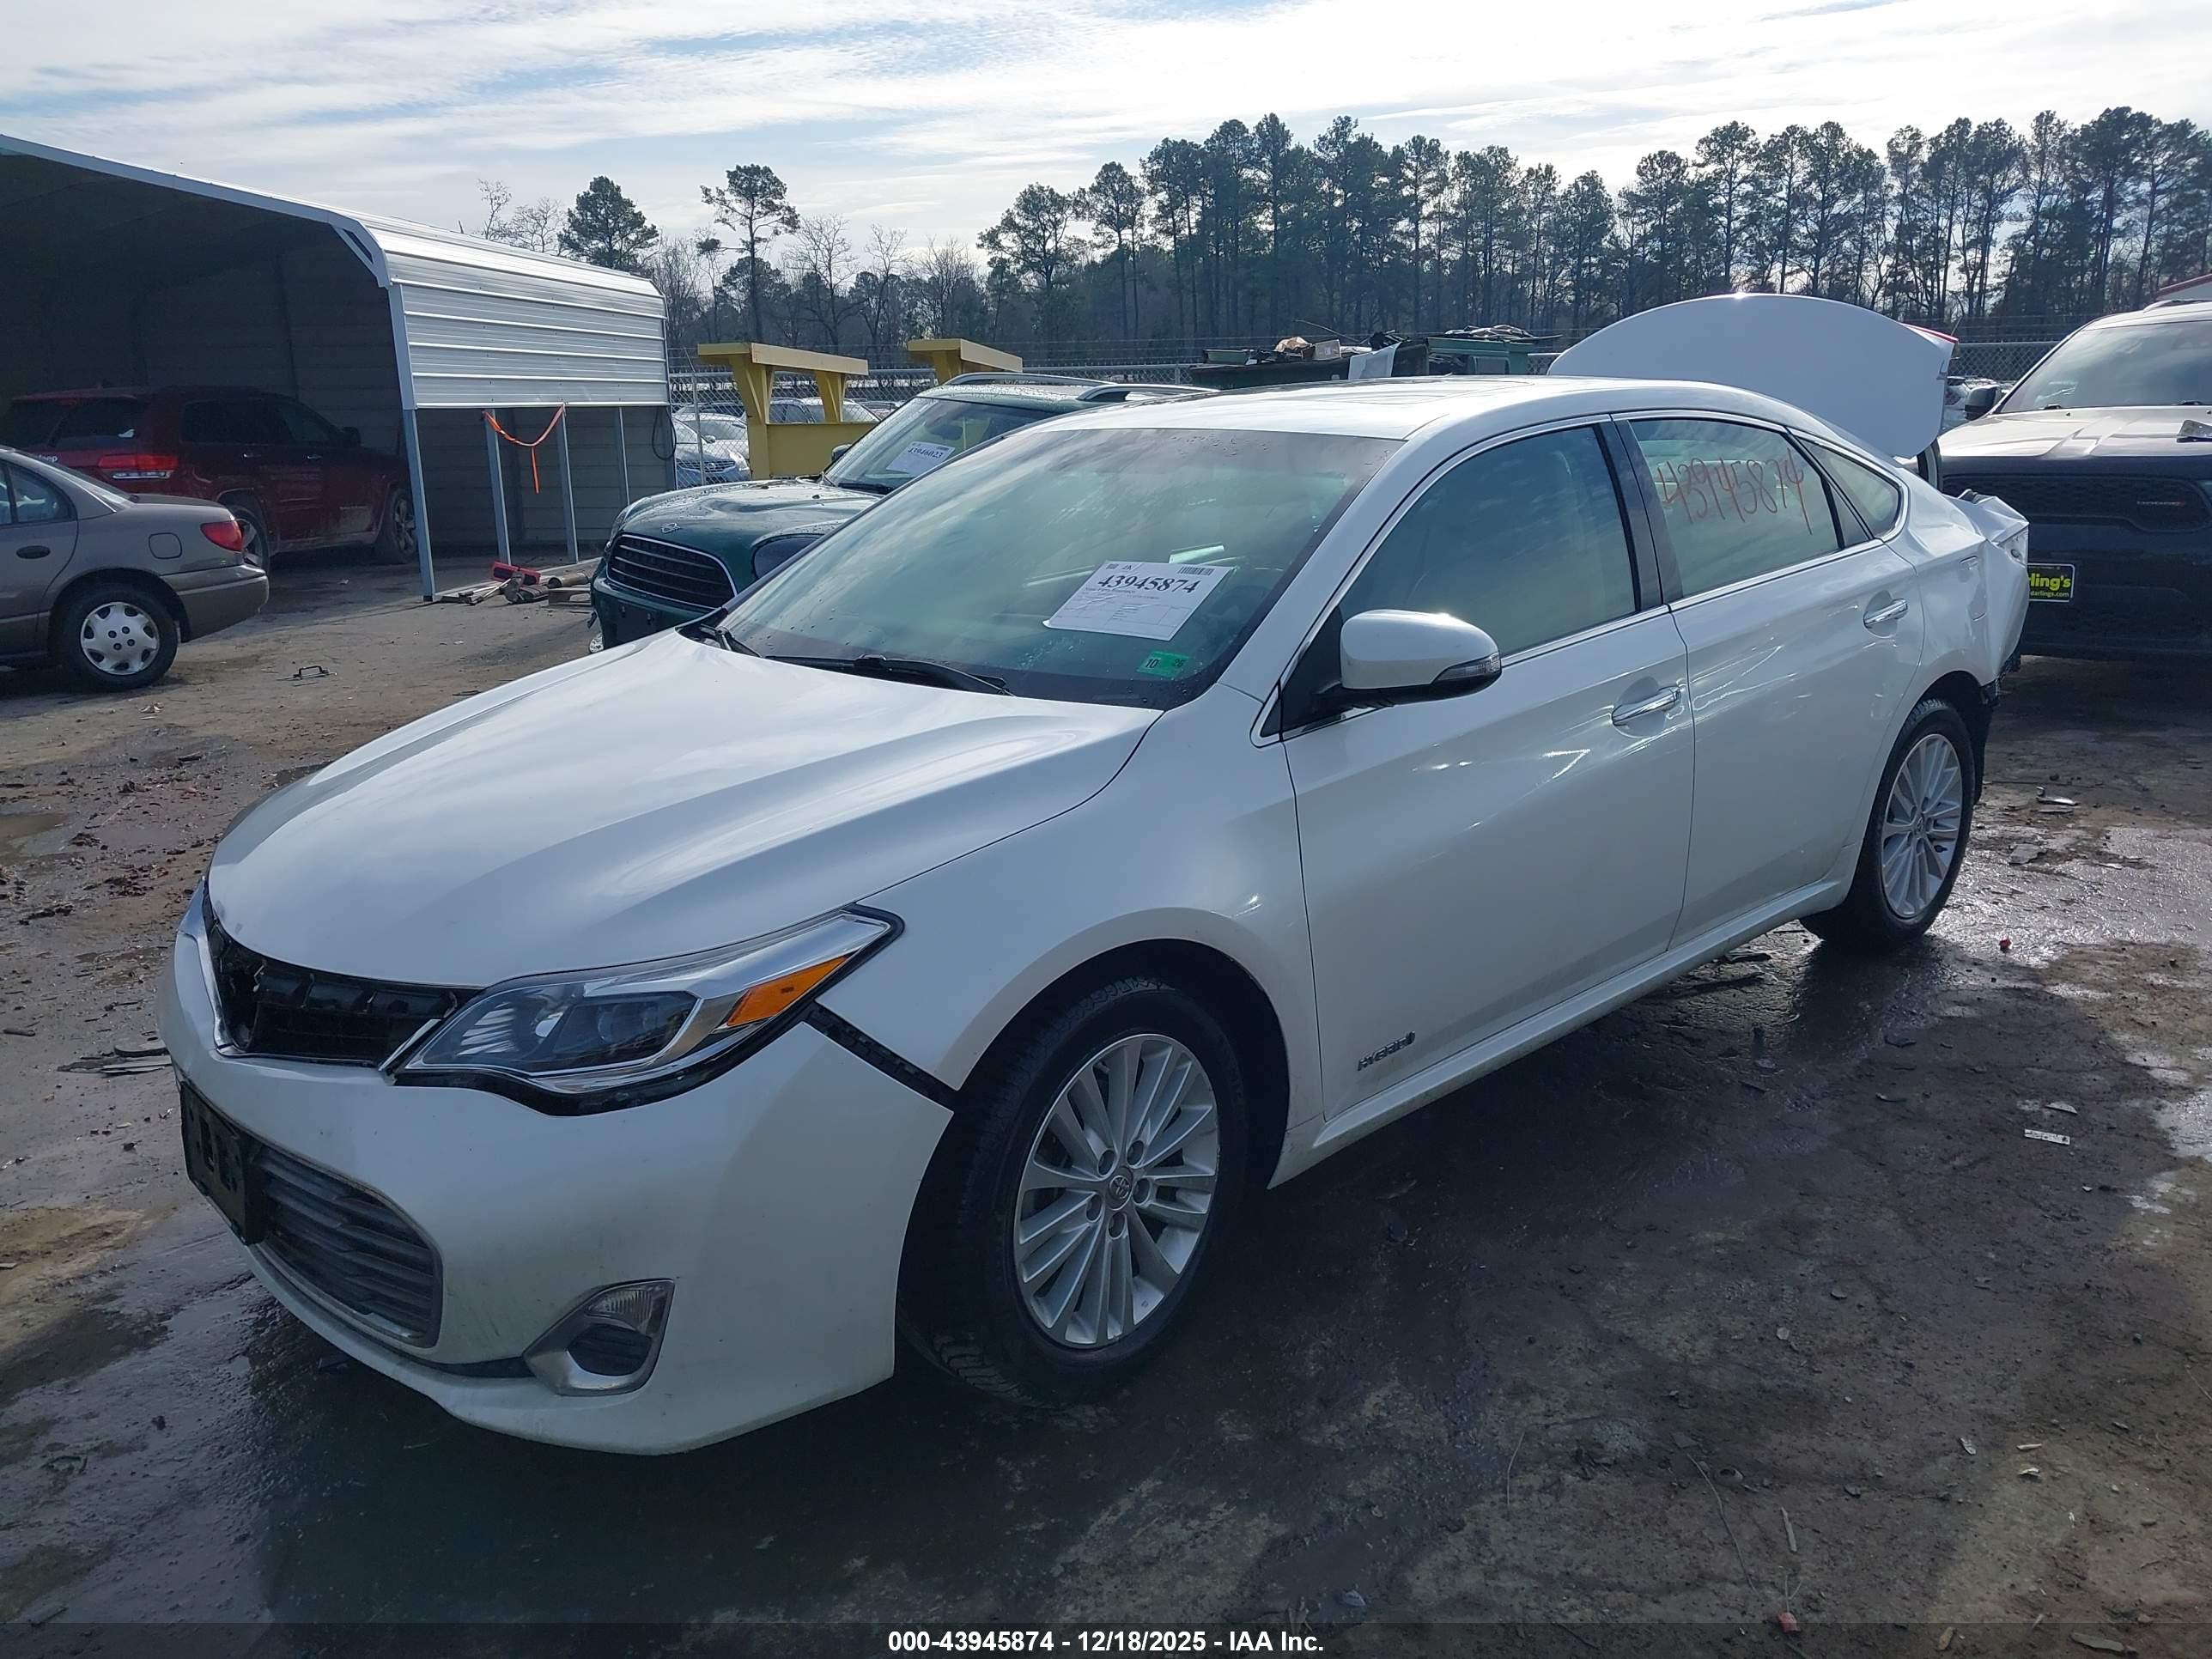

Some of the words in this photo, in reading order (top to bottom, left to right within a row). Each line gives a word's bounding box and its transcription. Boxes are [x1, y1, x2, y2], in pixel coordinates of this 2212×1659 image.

[1657, 447, 1813, 536] 43945874
[1097, 574, 1200, 593] 43945874
[1146, 659, 1159, 668] 10
